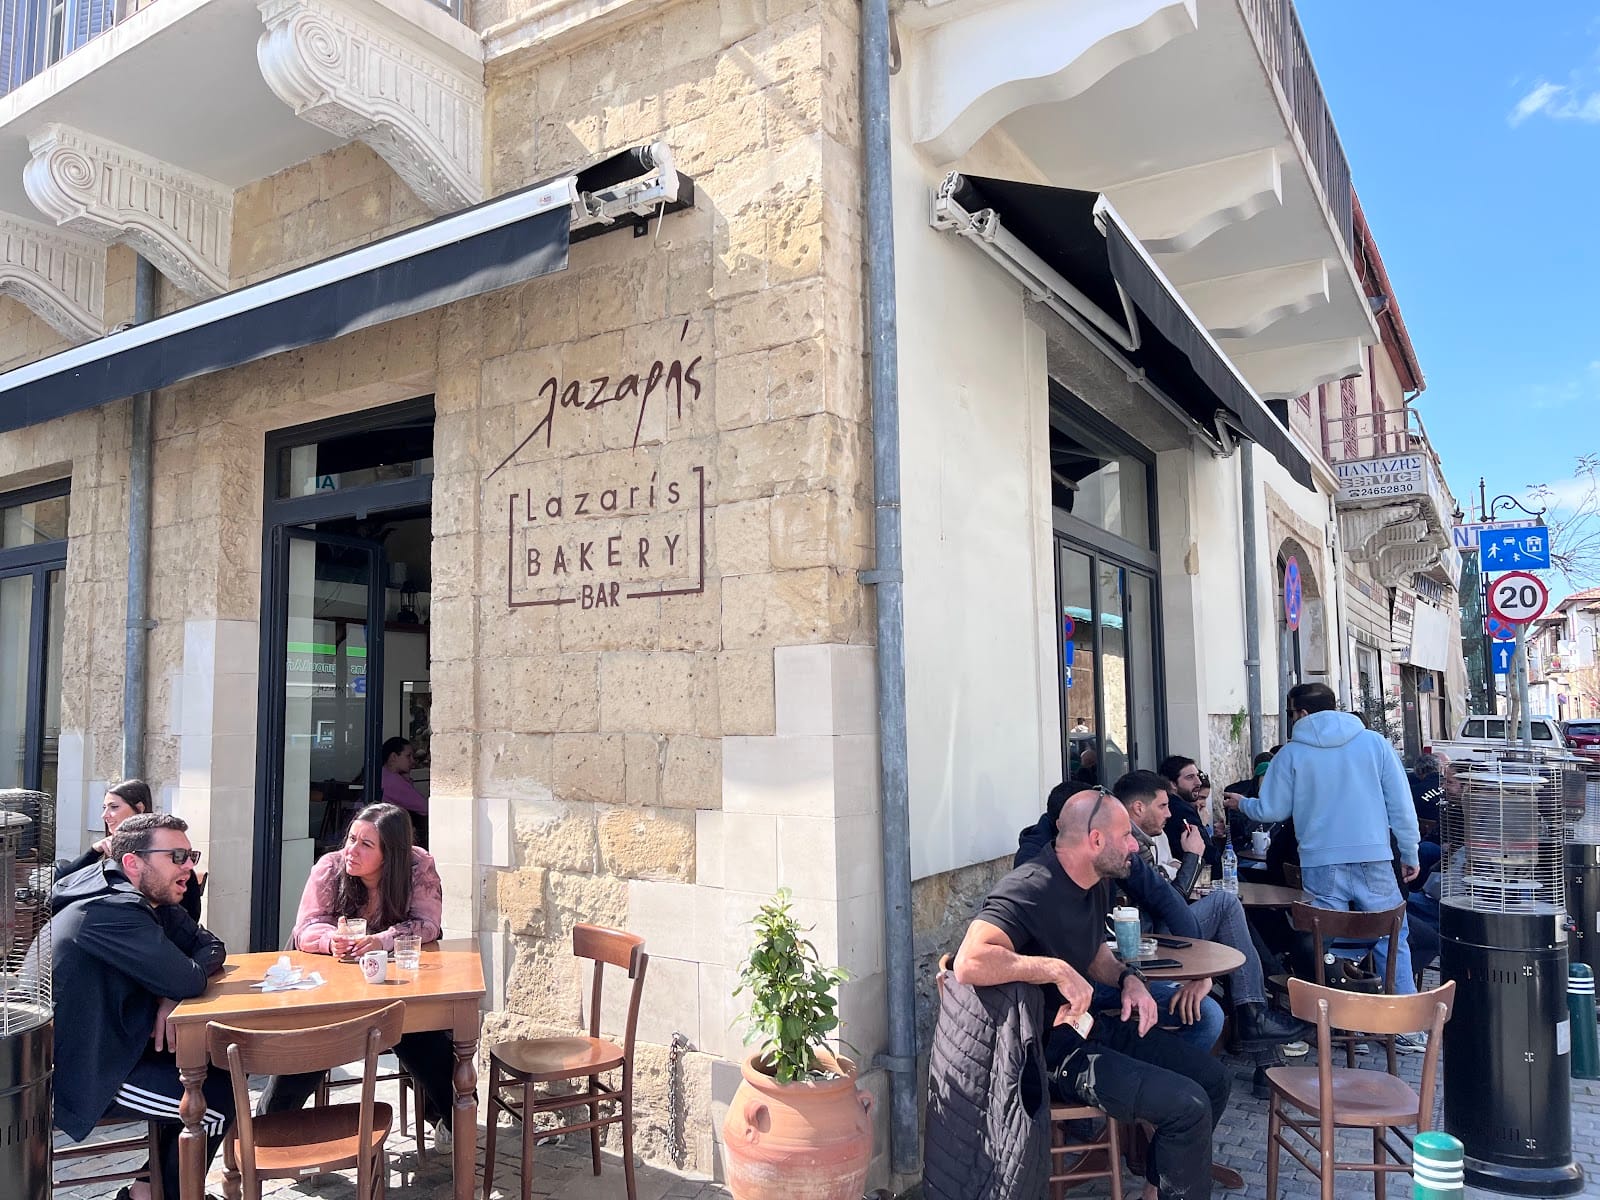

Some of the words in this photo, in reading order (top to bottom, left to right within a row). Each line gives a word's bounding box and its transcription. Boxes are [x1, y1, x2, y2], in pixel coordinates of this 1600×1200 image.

[1338, 457, 1421, 477] ΠΑΝΤΑΖΗΣ
[1340, 471, 1421, 488] SERVICE
[1361, 484, 1413, 497] 24652830
[527, 534, 680, 577] BAKERY
[581, 581, 620, 610] BAR
[1499, 585, 1537, 609] 20
